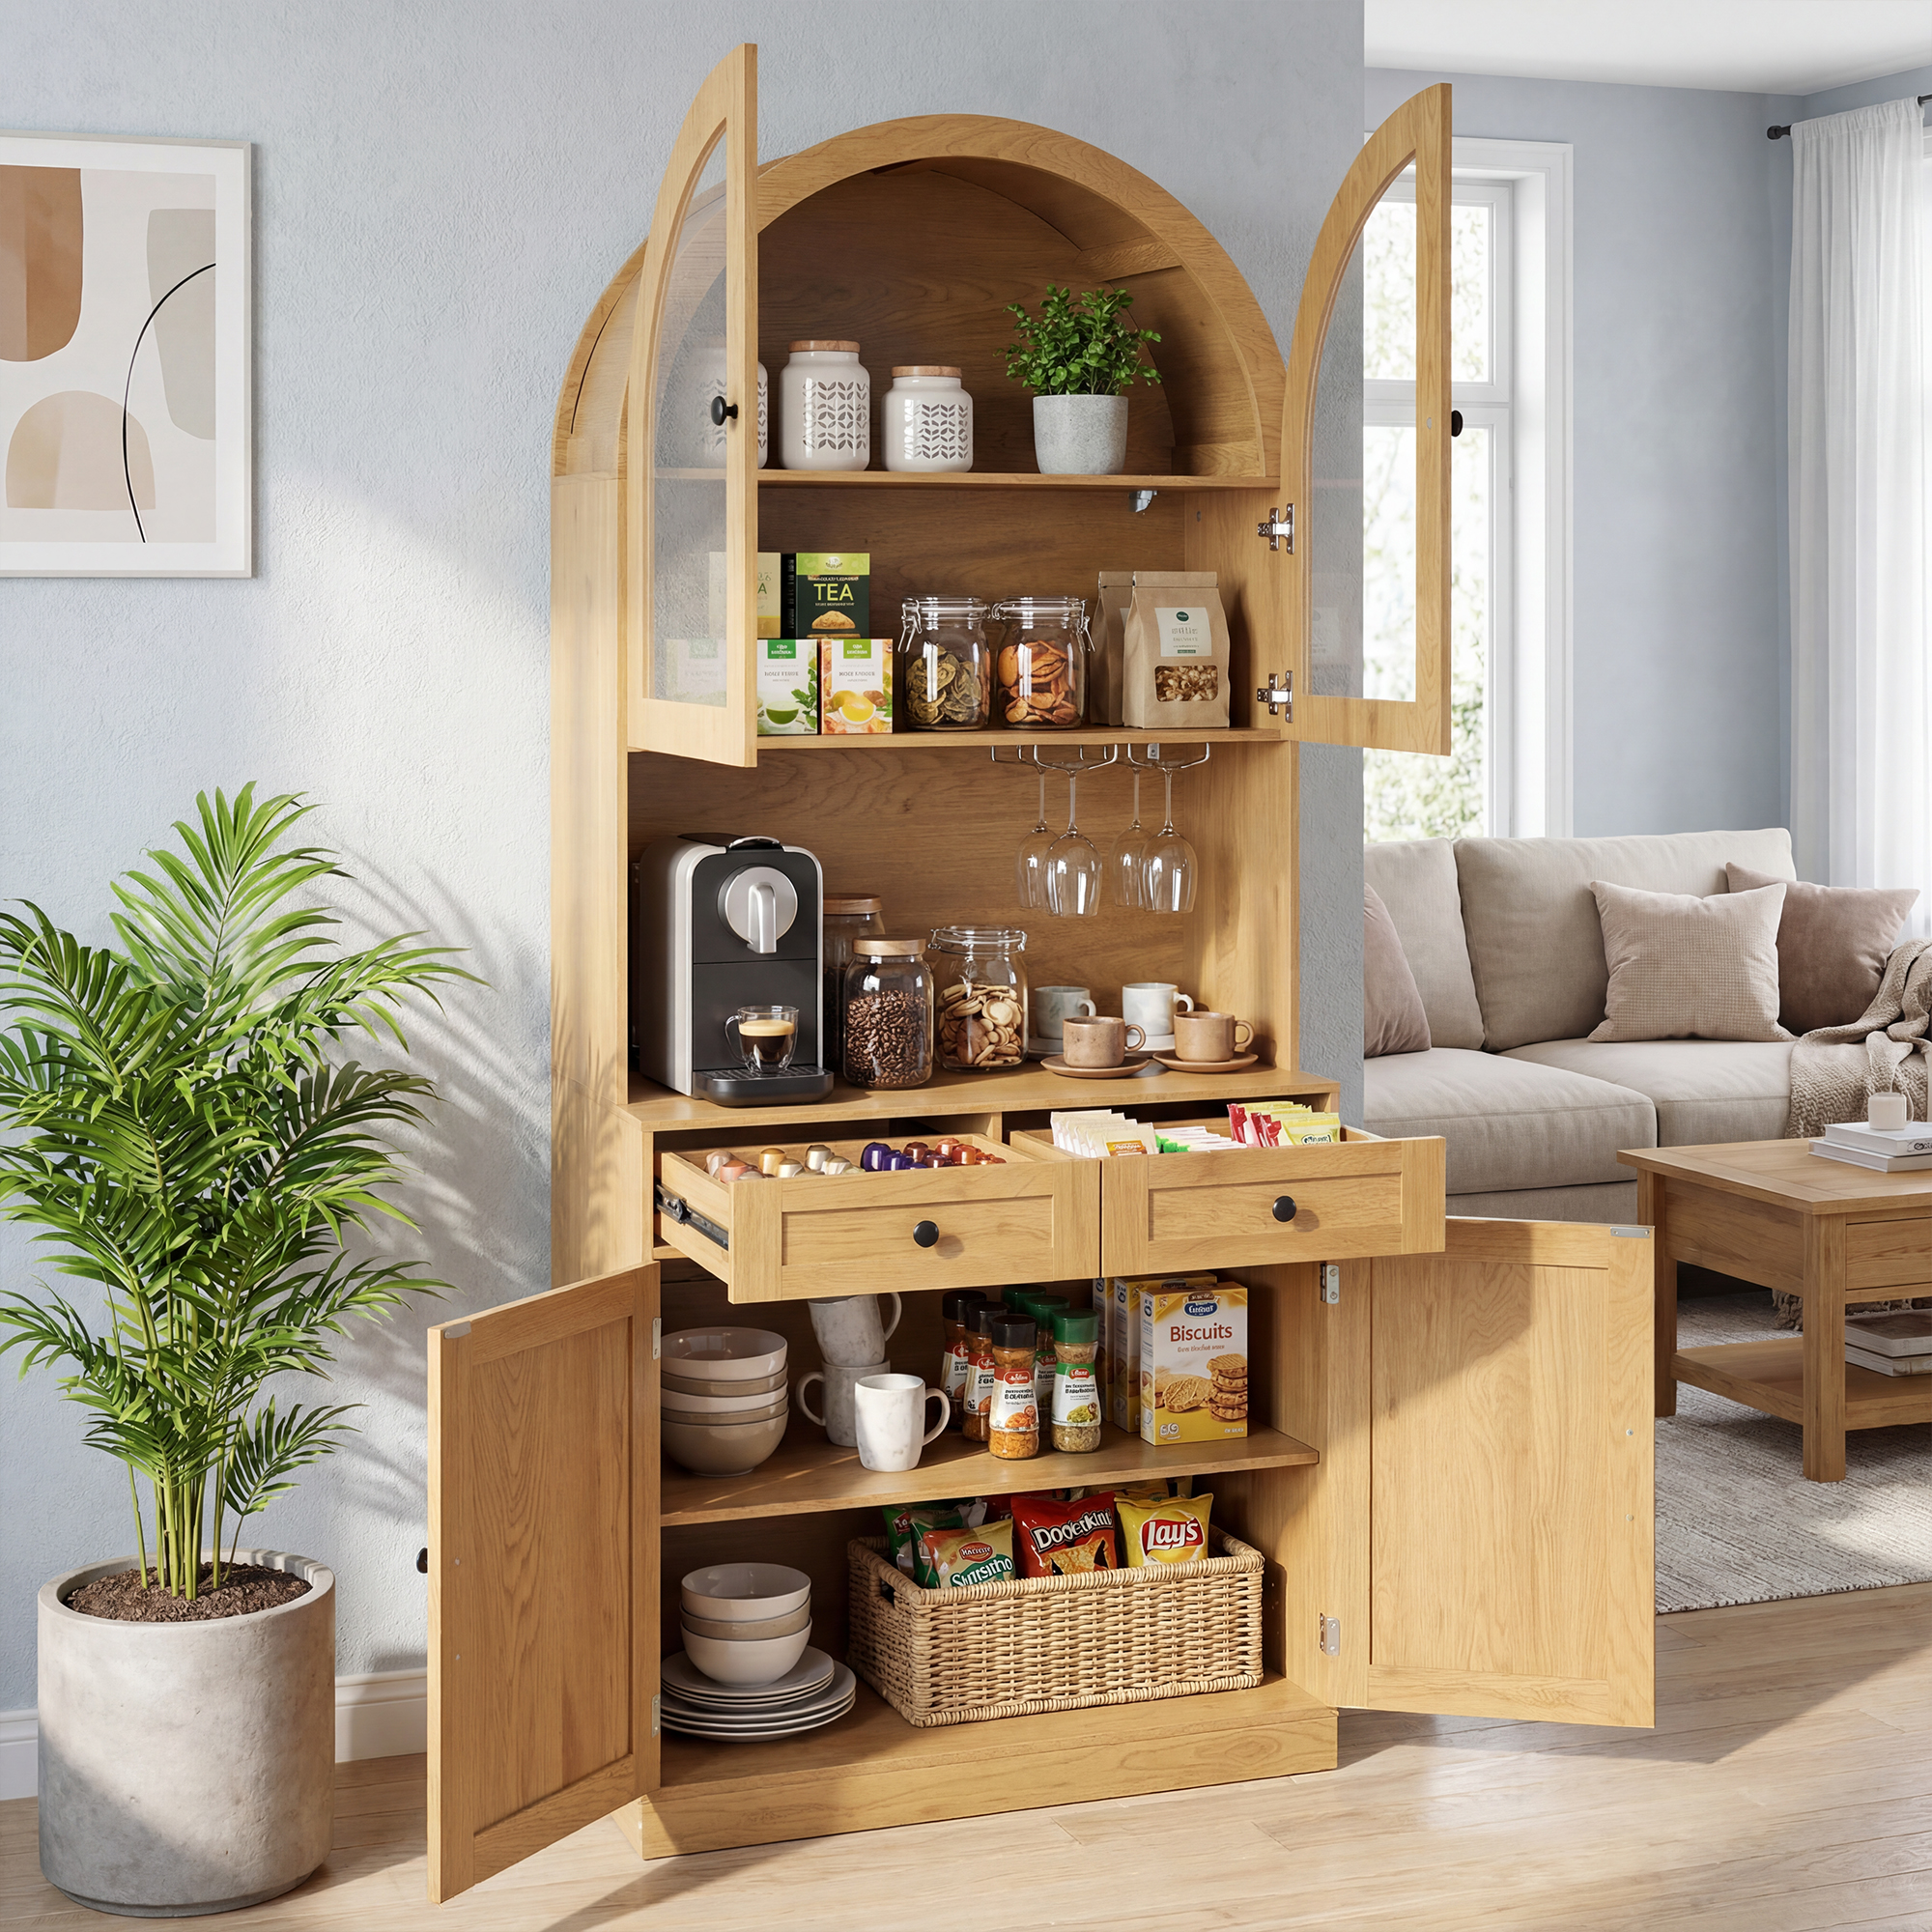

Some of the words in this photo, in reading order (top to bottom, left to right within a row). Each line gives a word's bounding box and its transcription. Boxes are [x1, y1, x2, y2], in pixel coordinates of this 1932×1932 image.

[813, 582, 854, 601] TEA
[1171, 1322, 1233, 1343] Biscuits
[1147, 1517, 1199, 1550] Lay's
